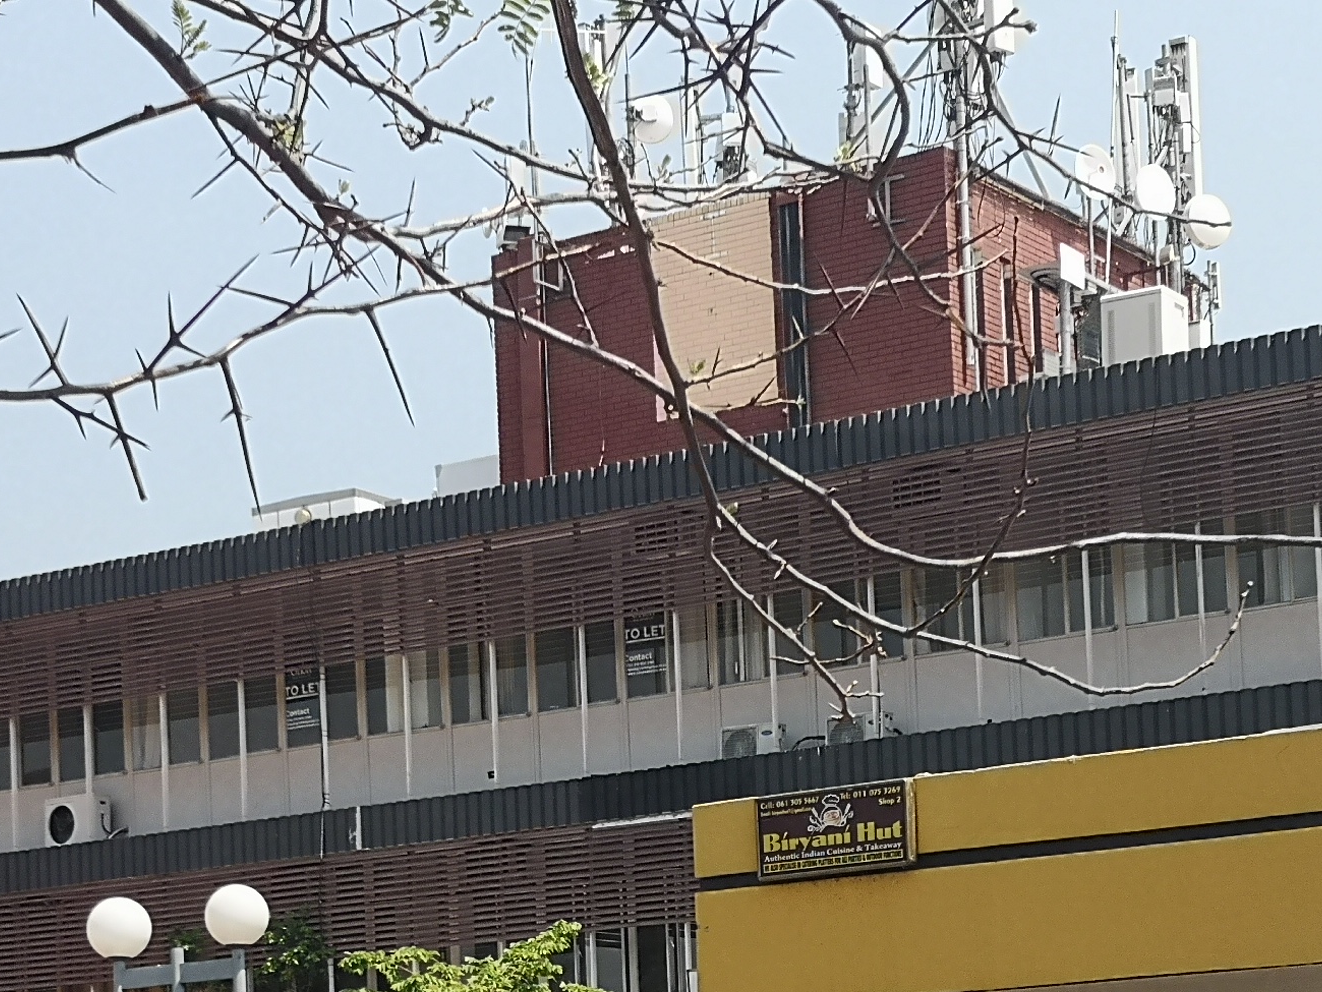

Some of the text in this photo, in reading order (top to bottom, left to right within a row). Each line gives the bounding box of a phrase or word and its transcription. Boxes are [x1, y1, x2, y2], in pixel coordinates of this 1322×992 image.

[625, 624, 665, 640] TO LET
[286, 686, 299, 696] TO
[852, 790, 866, 798] 011
[763, 820, 902, 854] Biryani Hut
[764, 852, 800, 862] Authentic
[801, 850, 826, 858] Indian
[826, 847, 854, 856] Cuisine
[864, 842, 902, 852] Takeaway
